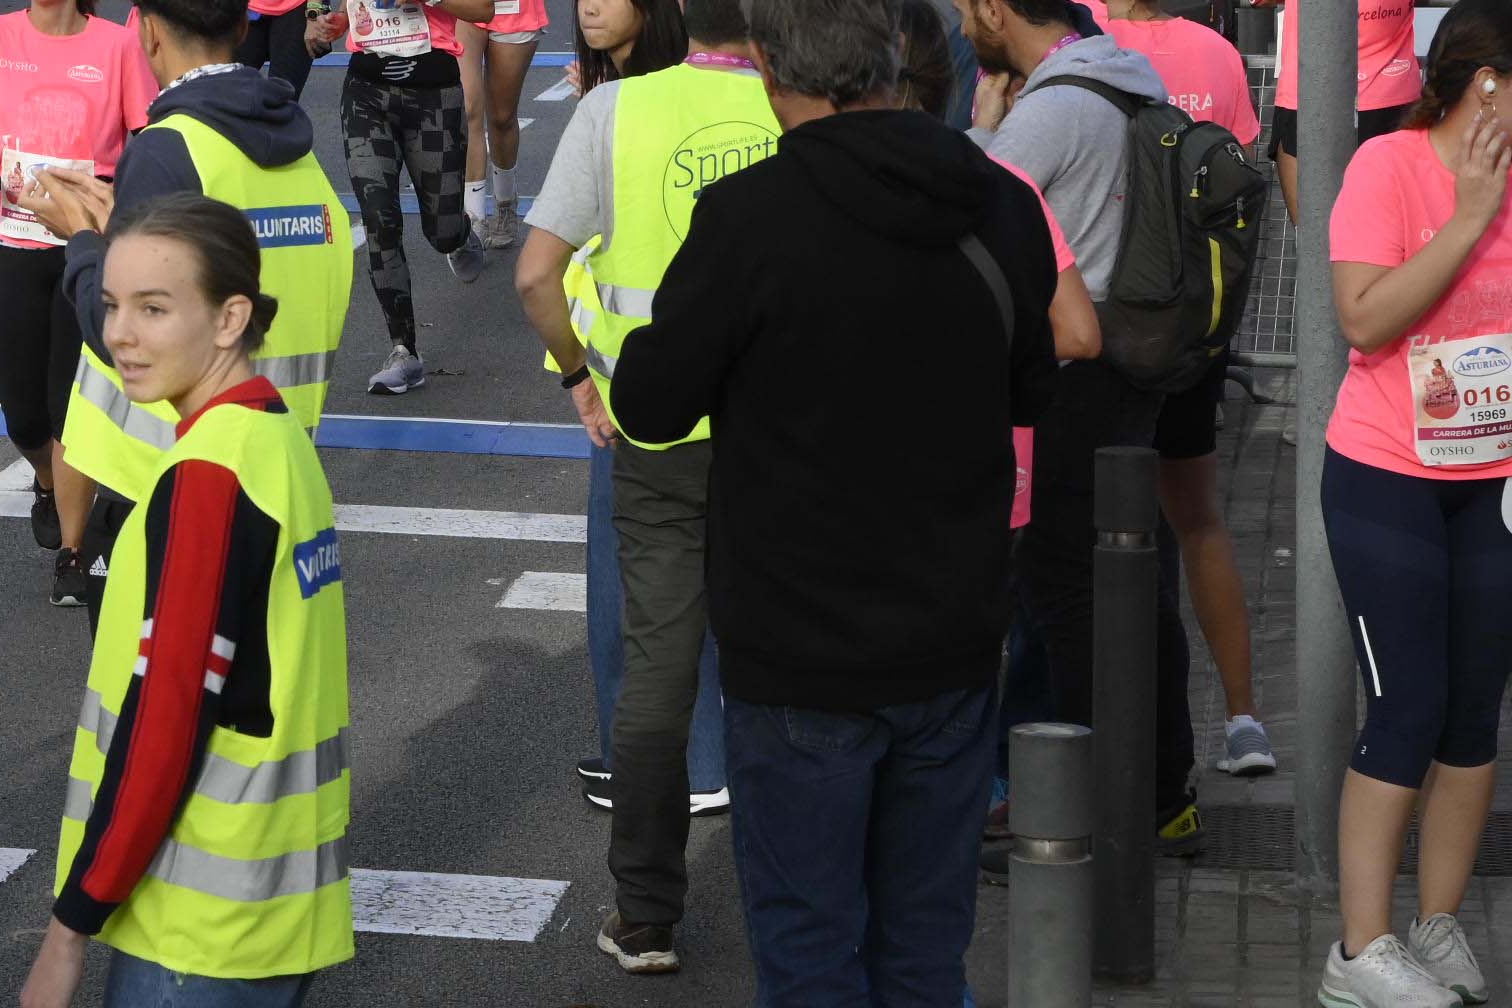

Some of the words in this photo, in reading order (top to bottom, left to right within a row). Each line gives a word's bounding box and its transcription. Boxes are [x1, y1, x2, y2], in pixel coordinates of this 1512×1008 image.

[375, 16, 401, 28] 016
[0, 58, 38, 73] OYSHO
[1457, 359, 1509, 372] ASTURIANA
[1463, 384, 1511, 406] 016
[1470, 408, 1506, 423] 15969
[1433, 429, 1473, 438] CARRERA
[1486, 426, 1498, 434] LA
[1430, 445, 1475, 457] OYSHO
